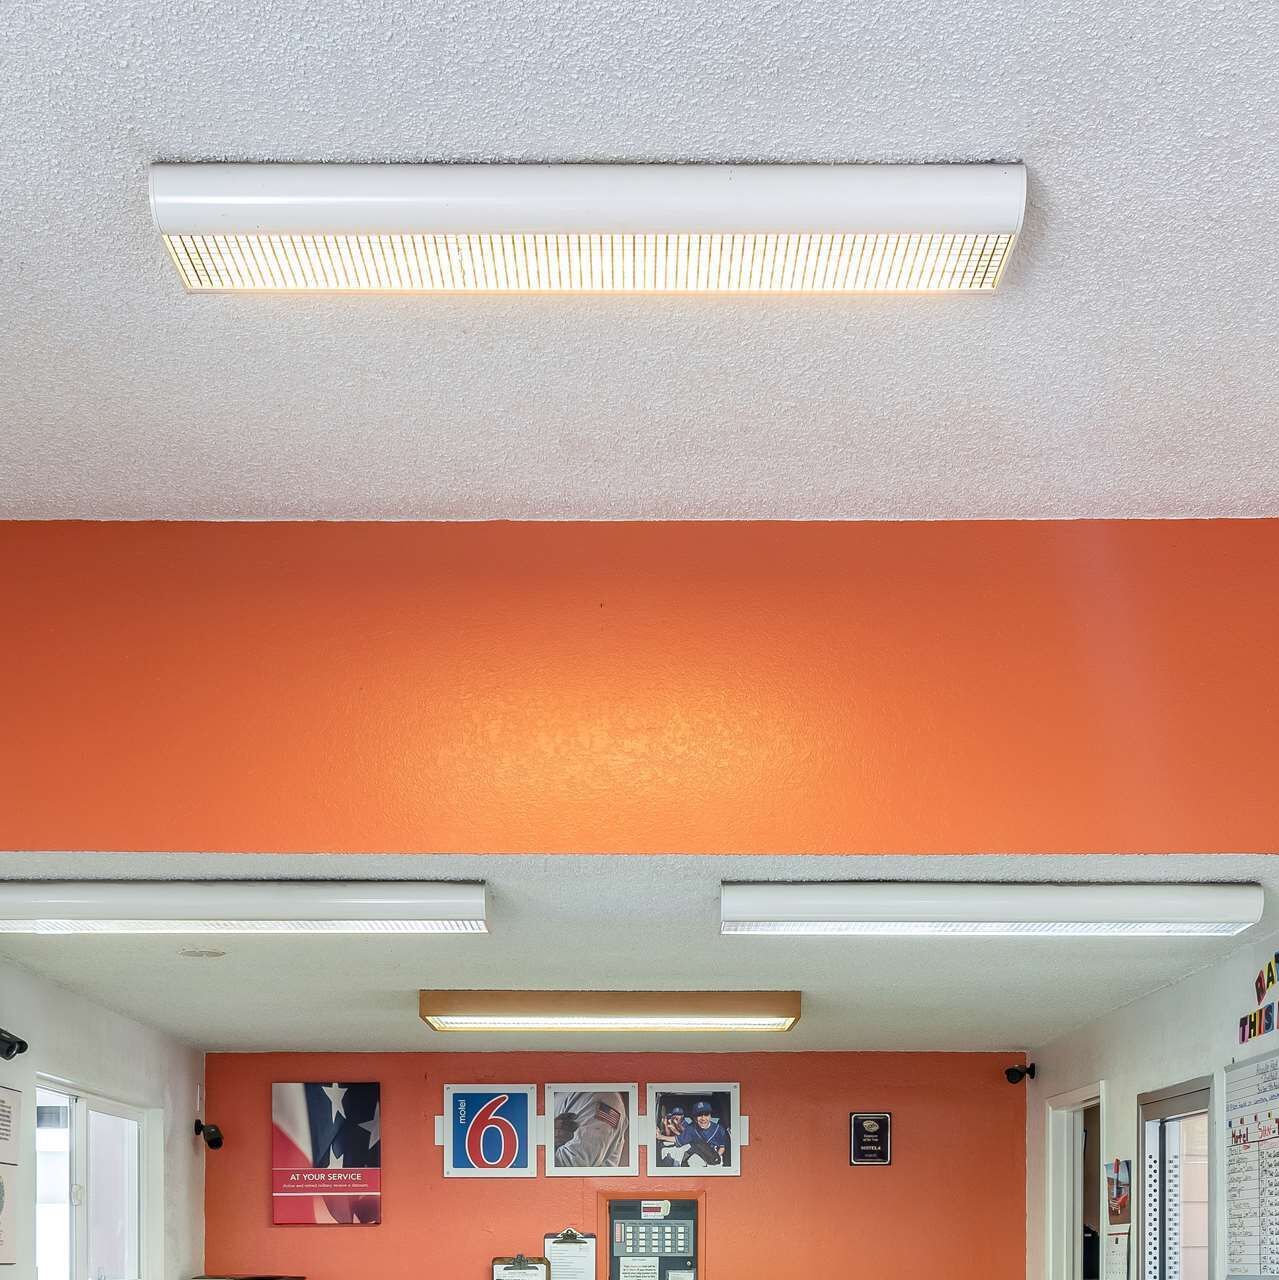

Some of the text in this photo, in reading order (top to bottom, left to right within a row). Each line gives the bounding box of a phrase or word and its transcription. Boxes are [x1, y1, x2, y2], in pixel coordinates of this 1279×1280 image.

[1240, 1003, 1275, 1043] THIS
[458, 1094, 519, 1168] motel 6
